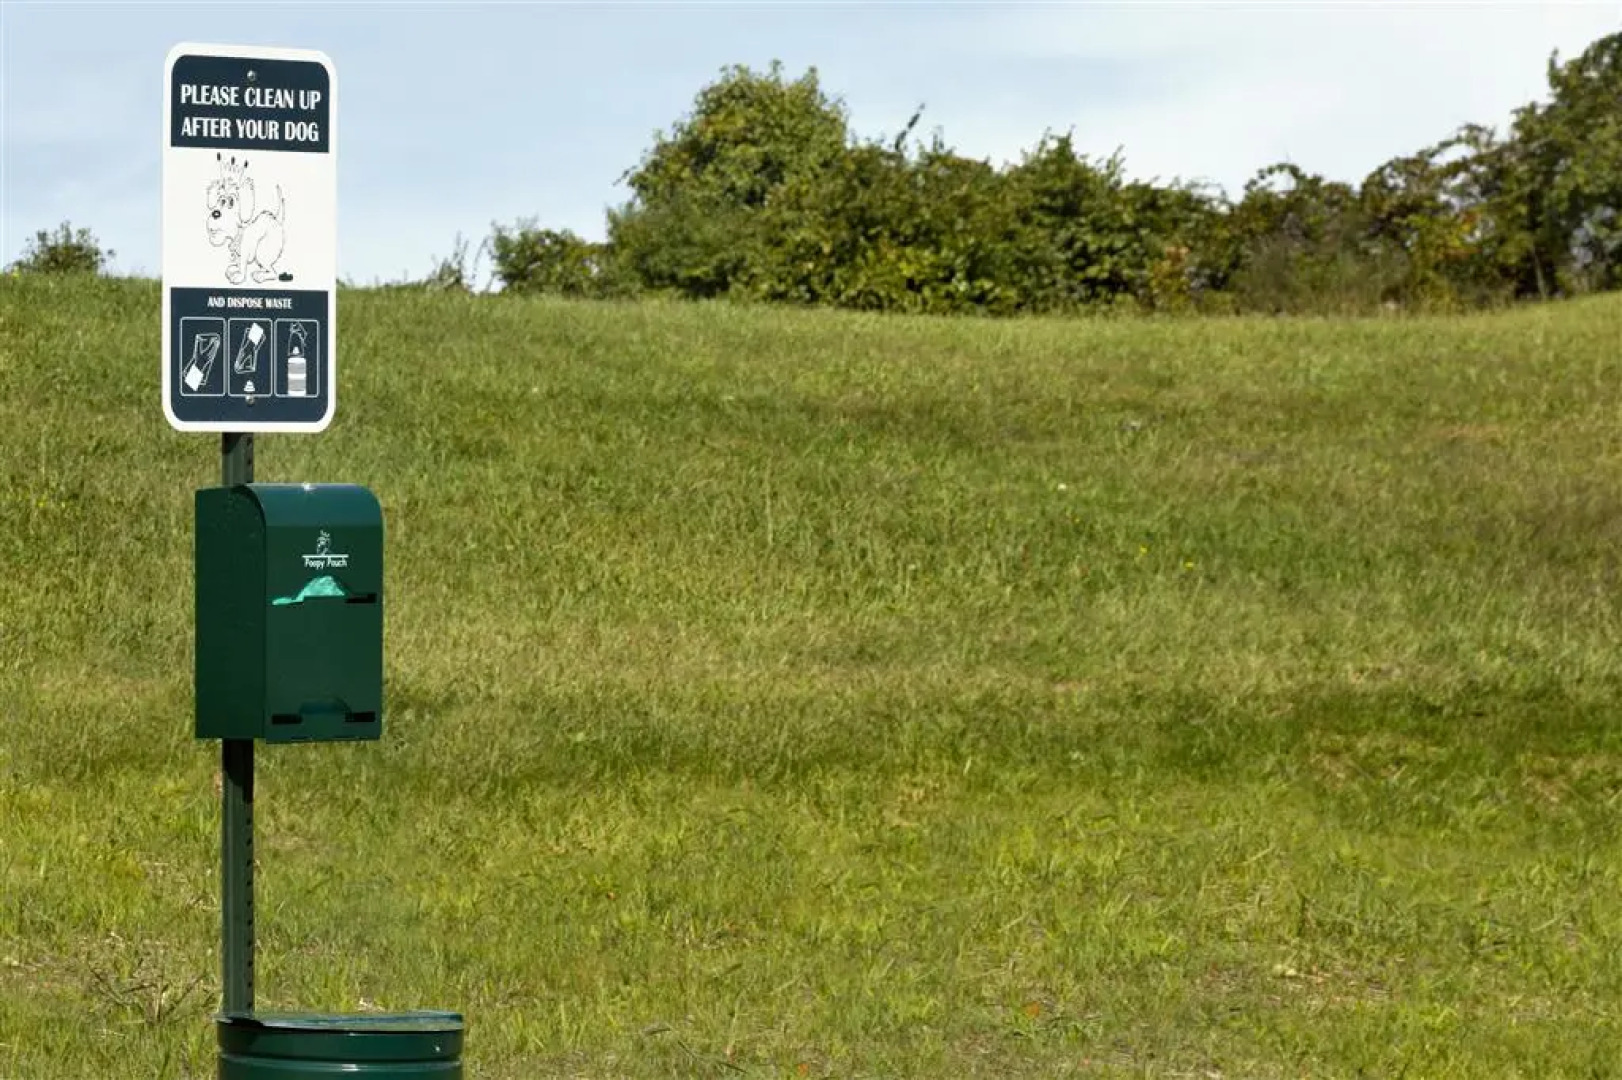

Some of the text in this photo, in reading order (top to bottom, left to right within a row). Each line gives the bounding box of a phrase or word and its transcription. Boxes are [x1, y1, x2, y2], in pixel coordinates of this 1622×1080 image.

[180, 83, 321, 110] PLEASE CLEAN UP
[181, 116, 319, 142] AFTER YOUR DOG
[207, 296, 293, 310] AND DISPOSE WASTE
[304, 556, 348, 570] Poopy Pouch
